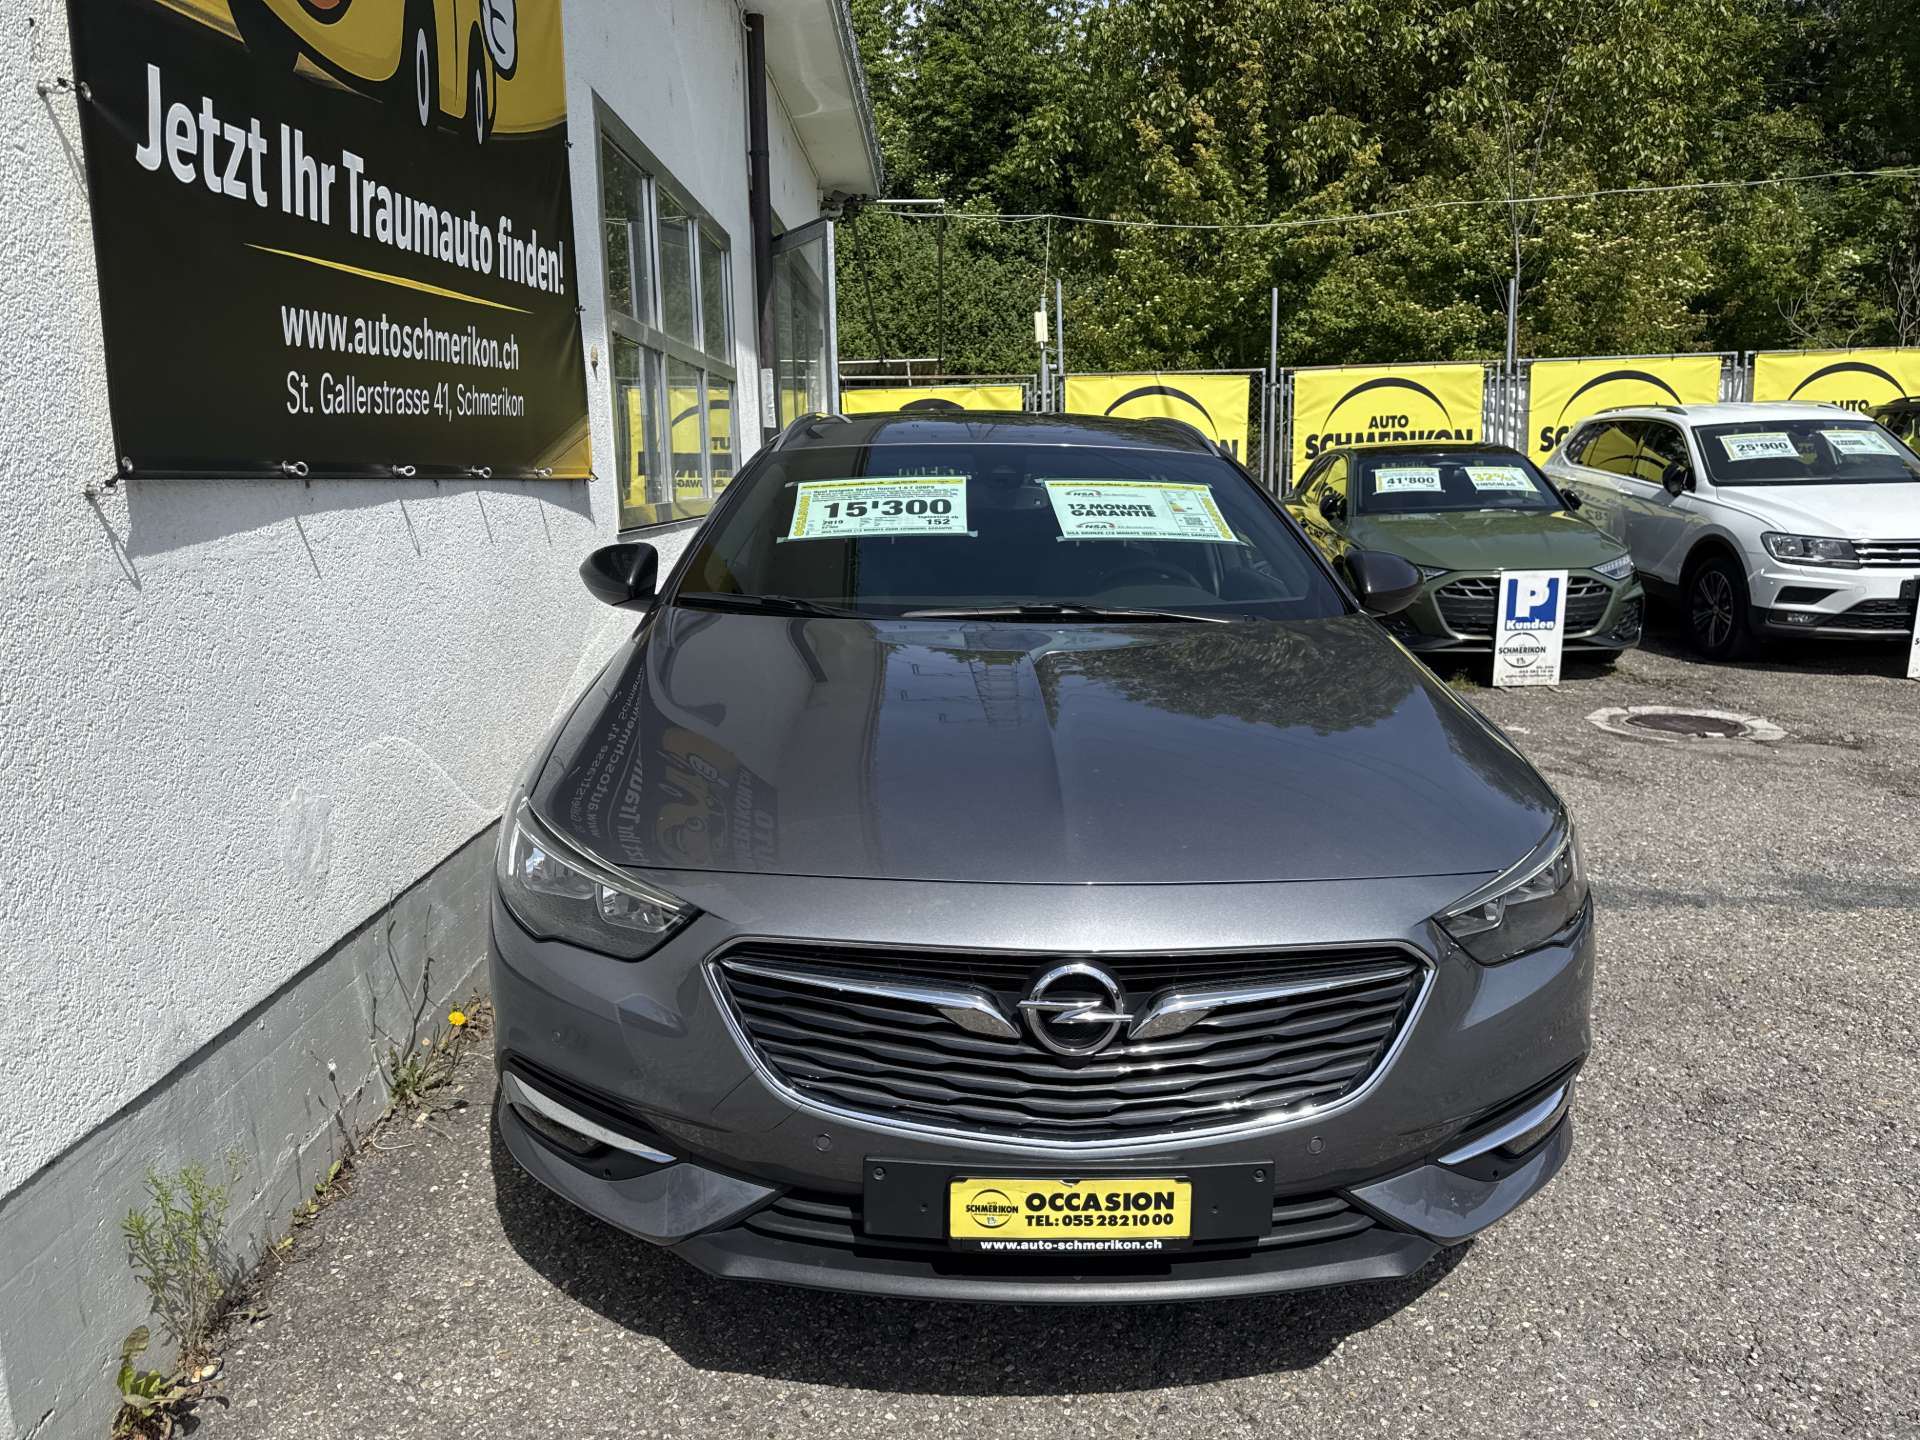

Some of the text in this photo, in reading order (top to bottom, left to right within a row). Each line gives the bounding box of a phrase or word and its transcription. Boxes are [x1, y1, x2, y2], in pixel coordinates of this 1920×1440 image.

[135, 63, 566, 295] Jetzt Ihr Traumauto finden!
[281, 305, 520, 371] www.autoschmerikon.ch
[286, 370, 525, 423] St. Gallerstrasse 41, Schmerikon
[1368, 415, 1410, 429] AUTO
[1387, 477, 1435, 485] 41'800
[823, 499, 953, 518] 15'300
[1089, 503, 1153, 511] MONATE
[1506, 618, 1555, 630] Kunden
[1498, 646, 1547, 655] SCHMERIKON
[1025, 1192, 1175, 1212] OCCASION
[966, 1204, 1019, 1214] SCHMERIKON
[1025, 1214, 1060, 1227] TEL:
[980, 1239, 1163, 1250] www.auto-schmerikon.ch
